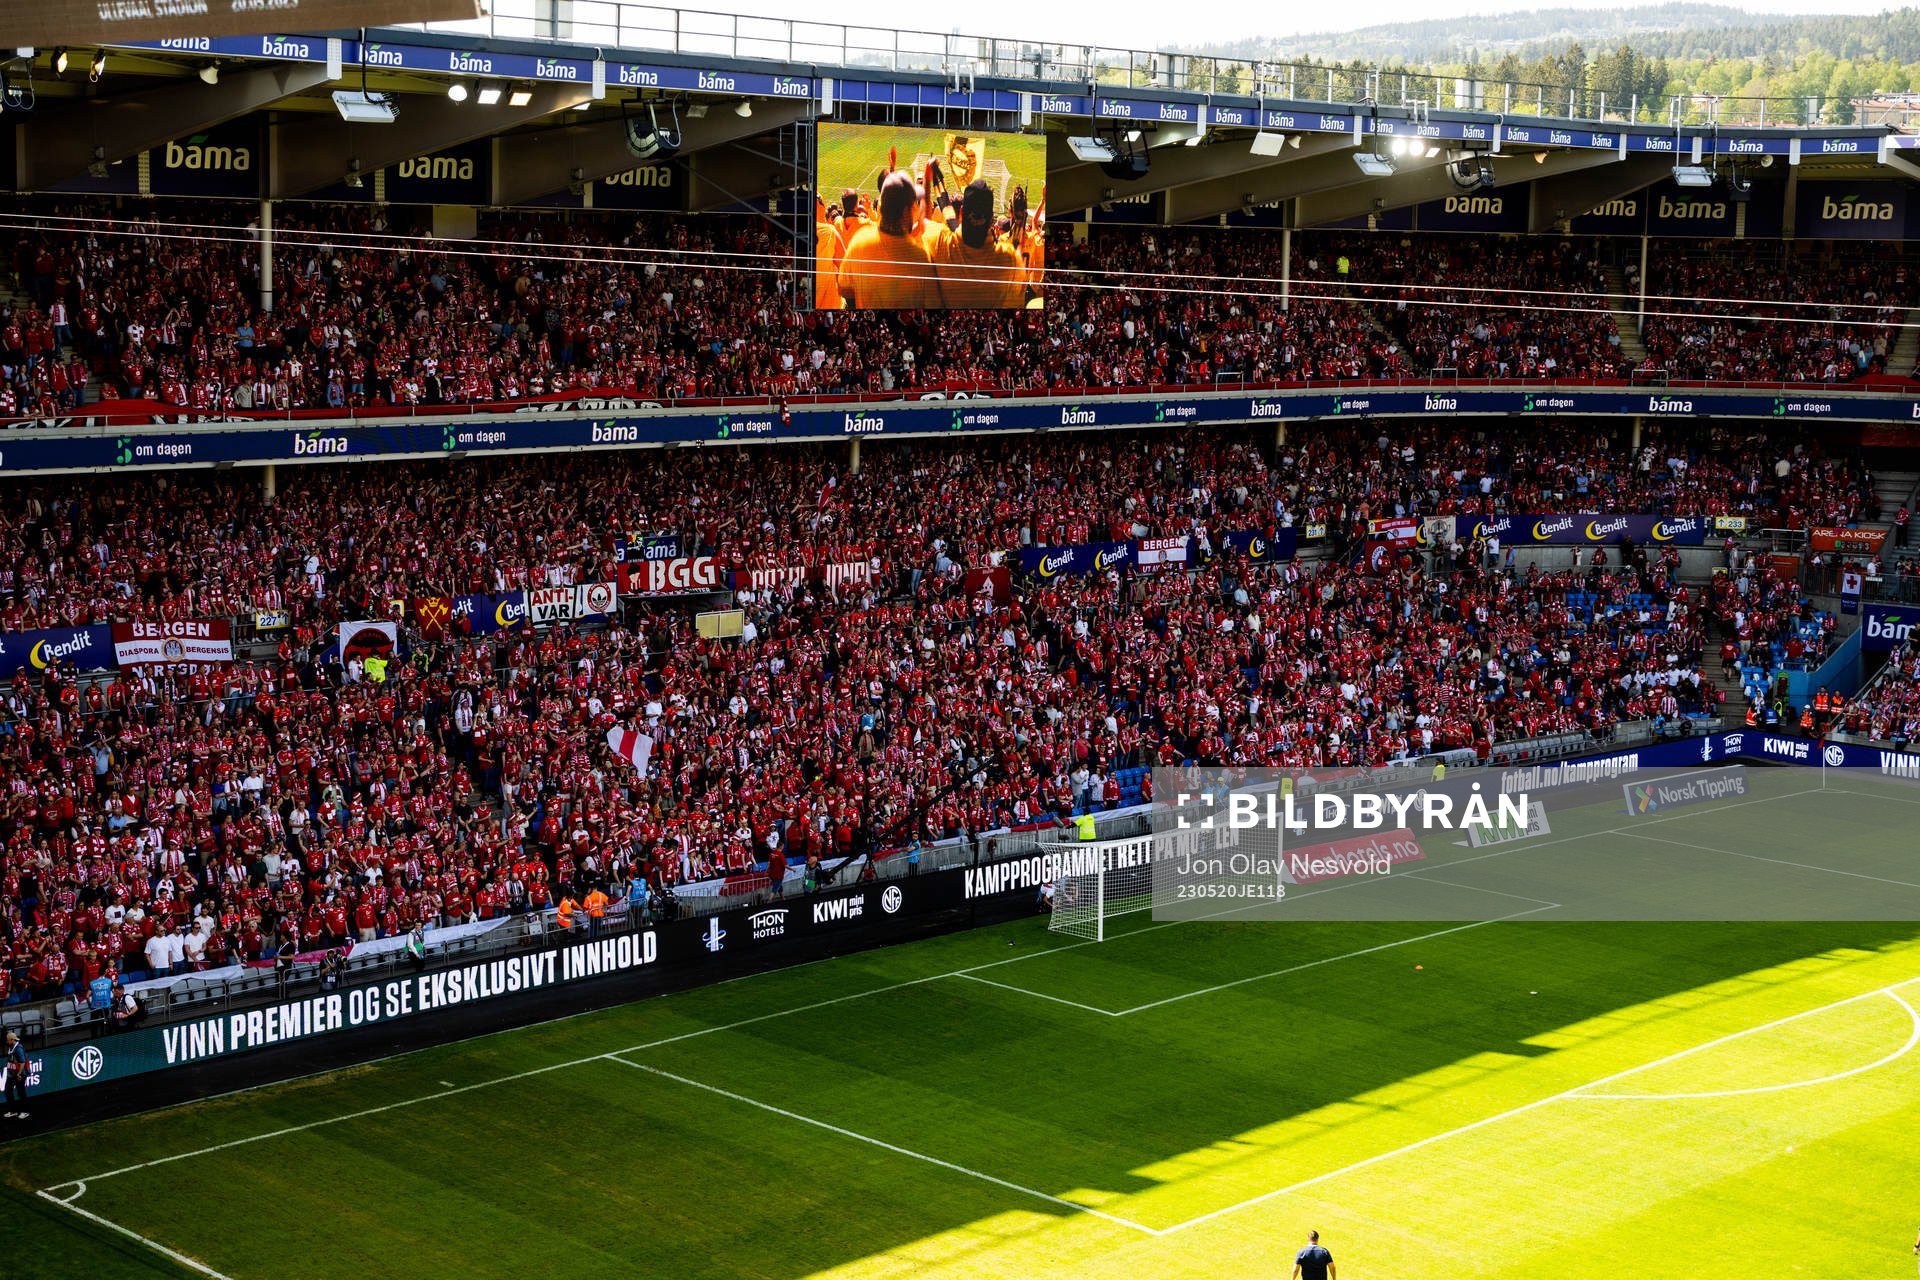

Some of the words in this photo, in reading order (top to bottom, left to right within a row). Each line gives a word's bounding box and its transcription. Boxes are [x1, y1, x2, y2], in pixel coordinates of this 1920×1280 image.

[1536, 399, 1547, 407] om
[1549, 397, 1574, 409] dagen
[1788, 403, 1801, 412] om
[1804, 402, 1830, 413] dagen
[964, 415, 975, 424] om
[977, 413, 999, 426] dagen
[1166, 407, 1176, 416] om
[1178, 405, 1196, 418] dagen
[732, 422, 744, 432] om
[746, 420, 772, 434] dagen
[458, 432, 474, 443] om
[476, 429, 506, 446] dagen
[136, 444, 153, 456] om
[156, 442, 192, 458] dagen
[1482, 517, 1511, 536] Bendit
[1541, 517, 1573, 535] Bendit
[1595, 517, 1628, 535] Bendit
[1662, 518, 1696, 536] Bendit
[1728, 520, 1743, 529] 233
[1854, 531, 1886, 540] KIOSK
[1046, 548, 1074, 571] Bendit
[1102, 544, 1128, 566] Bendit
[648, 556, 716, 591] BGG
[532, 589, 574, 606] ANTI-
[506, 603, 525, 619] Ben
[538, 605, 570, 619] VAR
[132, 622, 210, 637] BERGEN
[260, 617, 277, 626] 227
[1867, 616, 1914, 639] bam
[43, 631, 92, 660] Bendit
[119, 648, 159, 657] DIASPORA
[186, 646, 229, 655] BERGENSIS
[132, 664, 164, 678] NR
[1723, 734, 1744, 747] THON
[1764, 738, 1794, 756] KIWI
[1795, 742, 1809, 751] mini
[1725, 746, 1741, 754] HOTELS
[1795, 750, 1807, 759] pris
[1501, 752, 1638, 795] fotball.no/kampprogram
[1880, 752, 1920, 779] VINN
[1658, 782, 1698, 804] Norsk
[1700, 775, 1745, 798] Tipping
[1176, 827, 1239, 857] MOLEN
[813, 898, 847, 924] KIWI
[849, 894, 864, 907] mini
[849, 906, 862, 919] pris
[748, 908, 789, 929] THON
[753, 926, 784, 939] HOTELS
[163, 1018, 224, 1064] VINN
[230, 997, 342, 1051] PREMIER
[349, 990, 379, 1024] OG
[386, 984, 412, 1018] SE
[418, 949, 556, 1012] EKSKLUSIVT
[562, 930, 656, 984] INNHOLD
[29, 1058, 42, 1073] ini
[25, 1074, 40, 1087] ris
